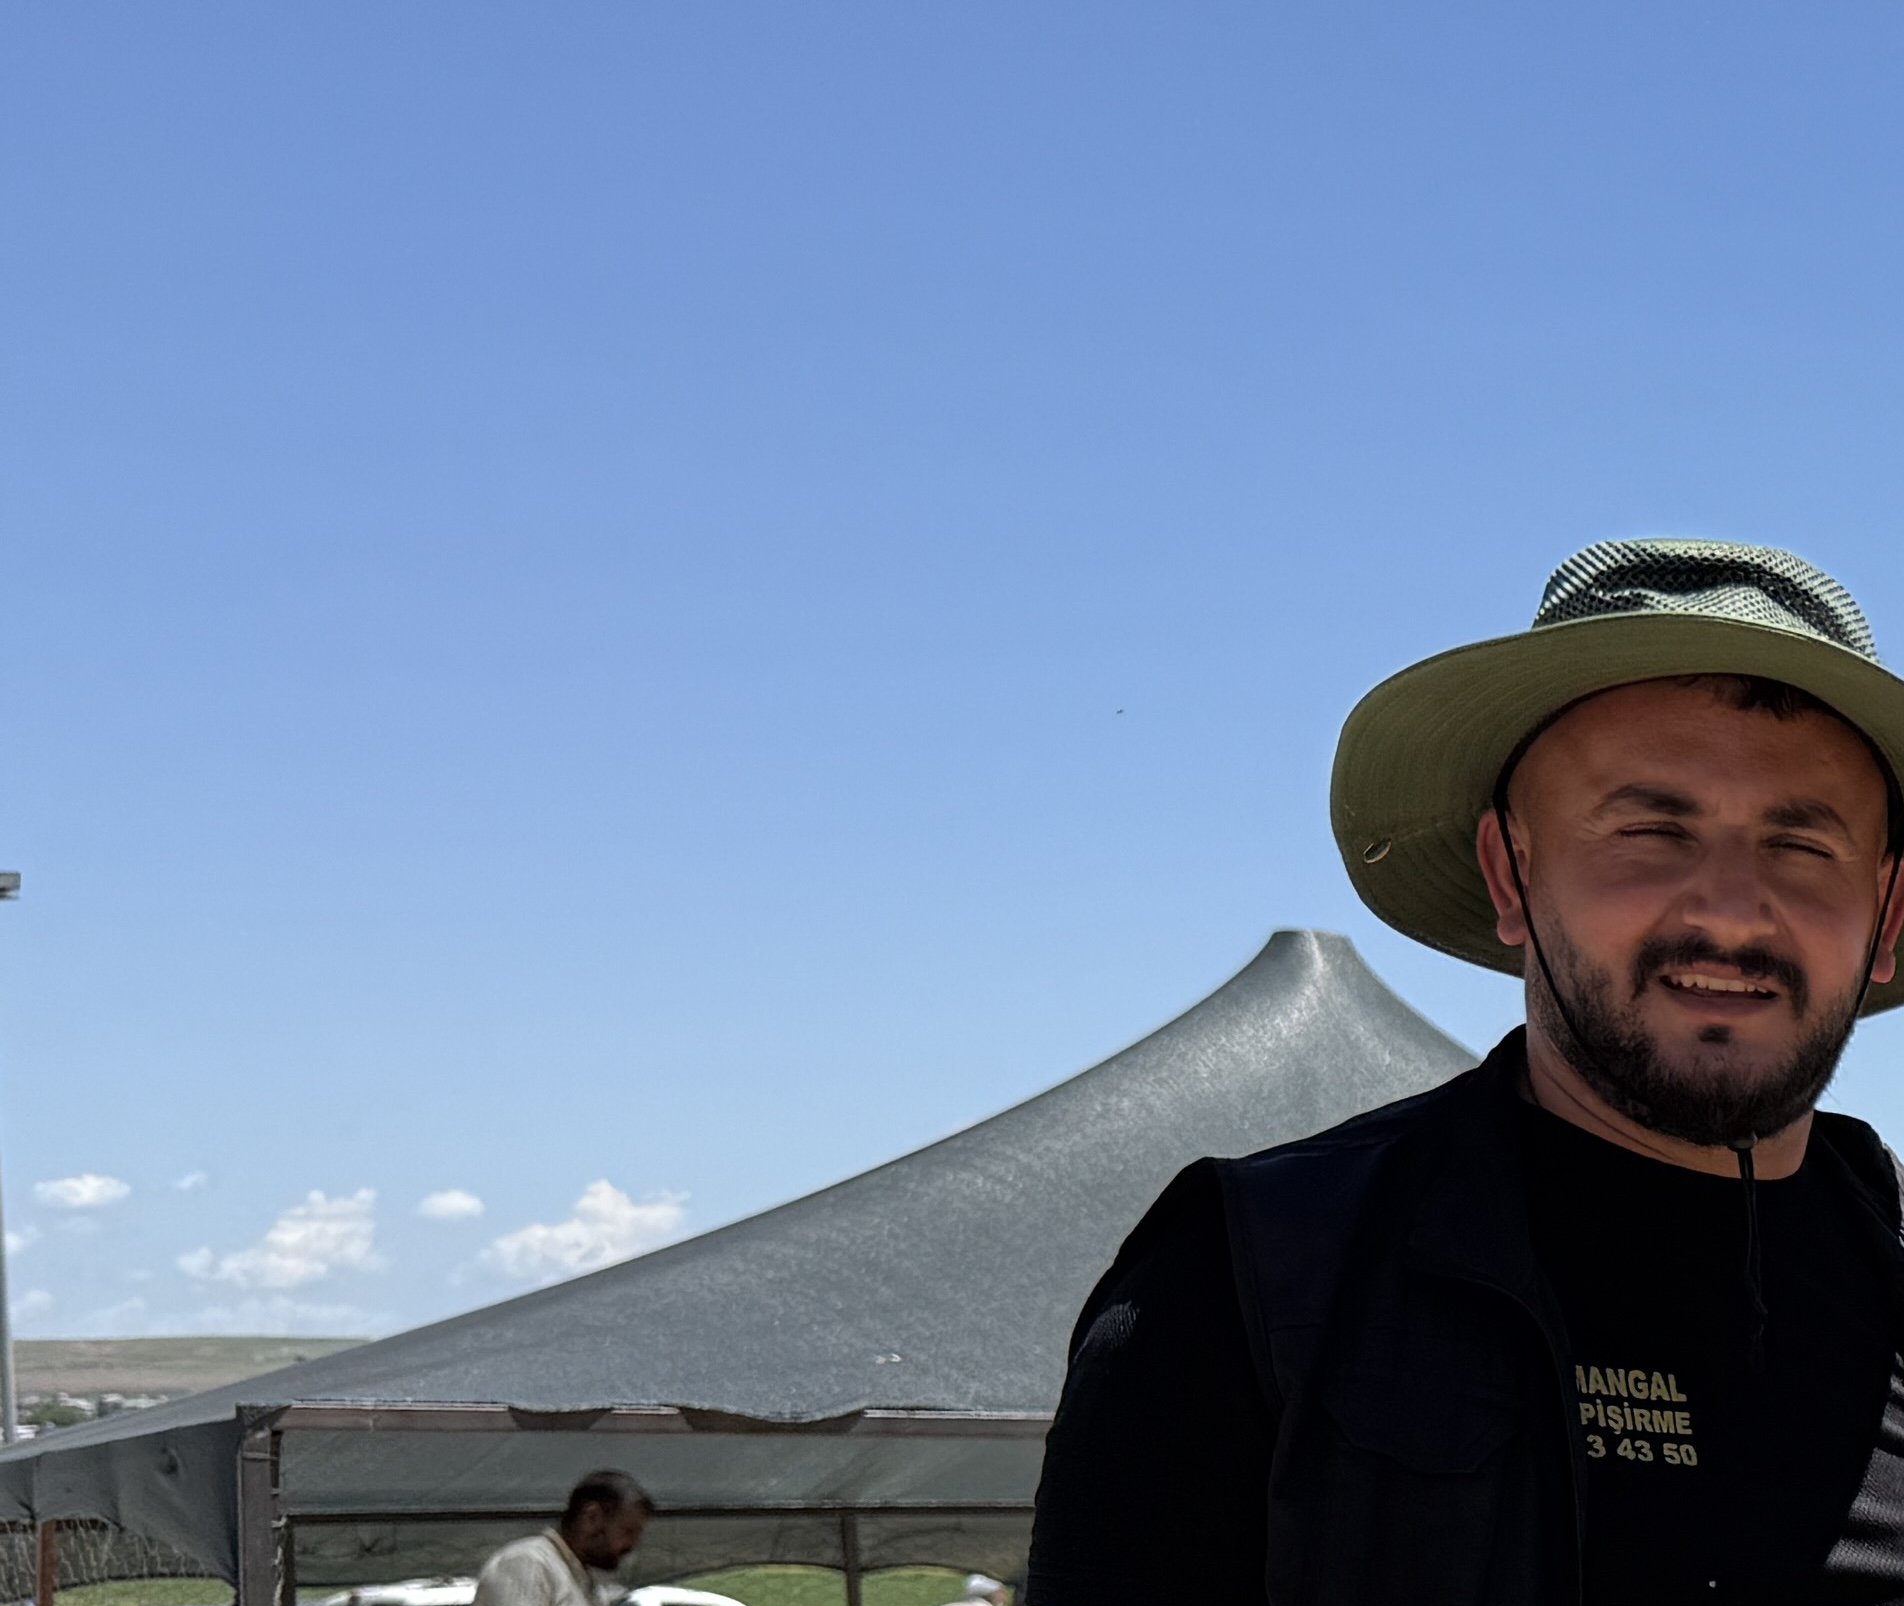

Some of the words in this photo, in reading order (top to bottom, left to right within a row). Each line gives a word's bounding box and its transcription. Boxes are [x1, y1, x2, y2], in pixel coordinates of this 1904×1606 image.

[1578, 1398, 1693, 1435] PİŞİRME
[1586, 1434, 1607, 1458] 3
[1616, 1438, 1654, 1462] 43
[1662, 1442, 1698, 1467] 50
